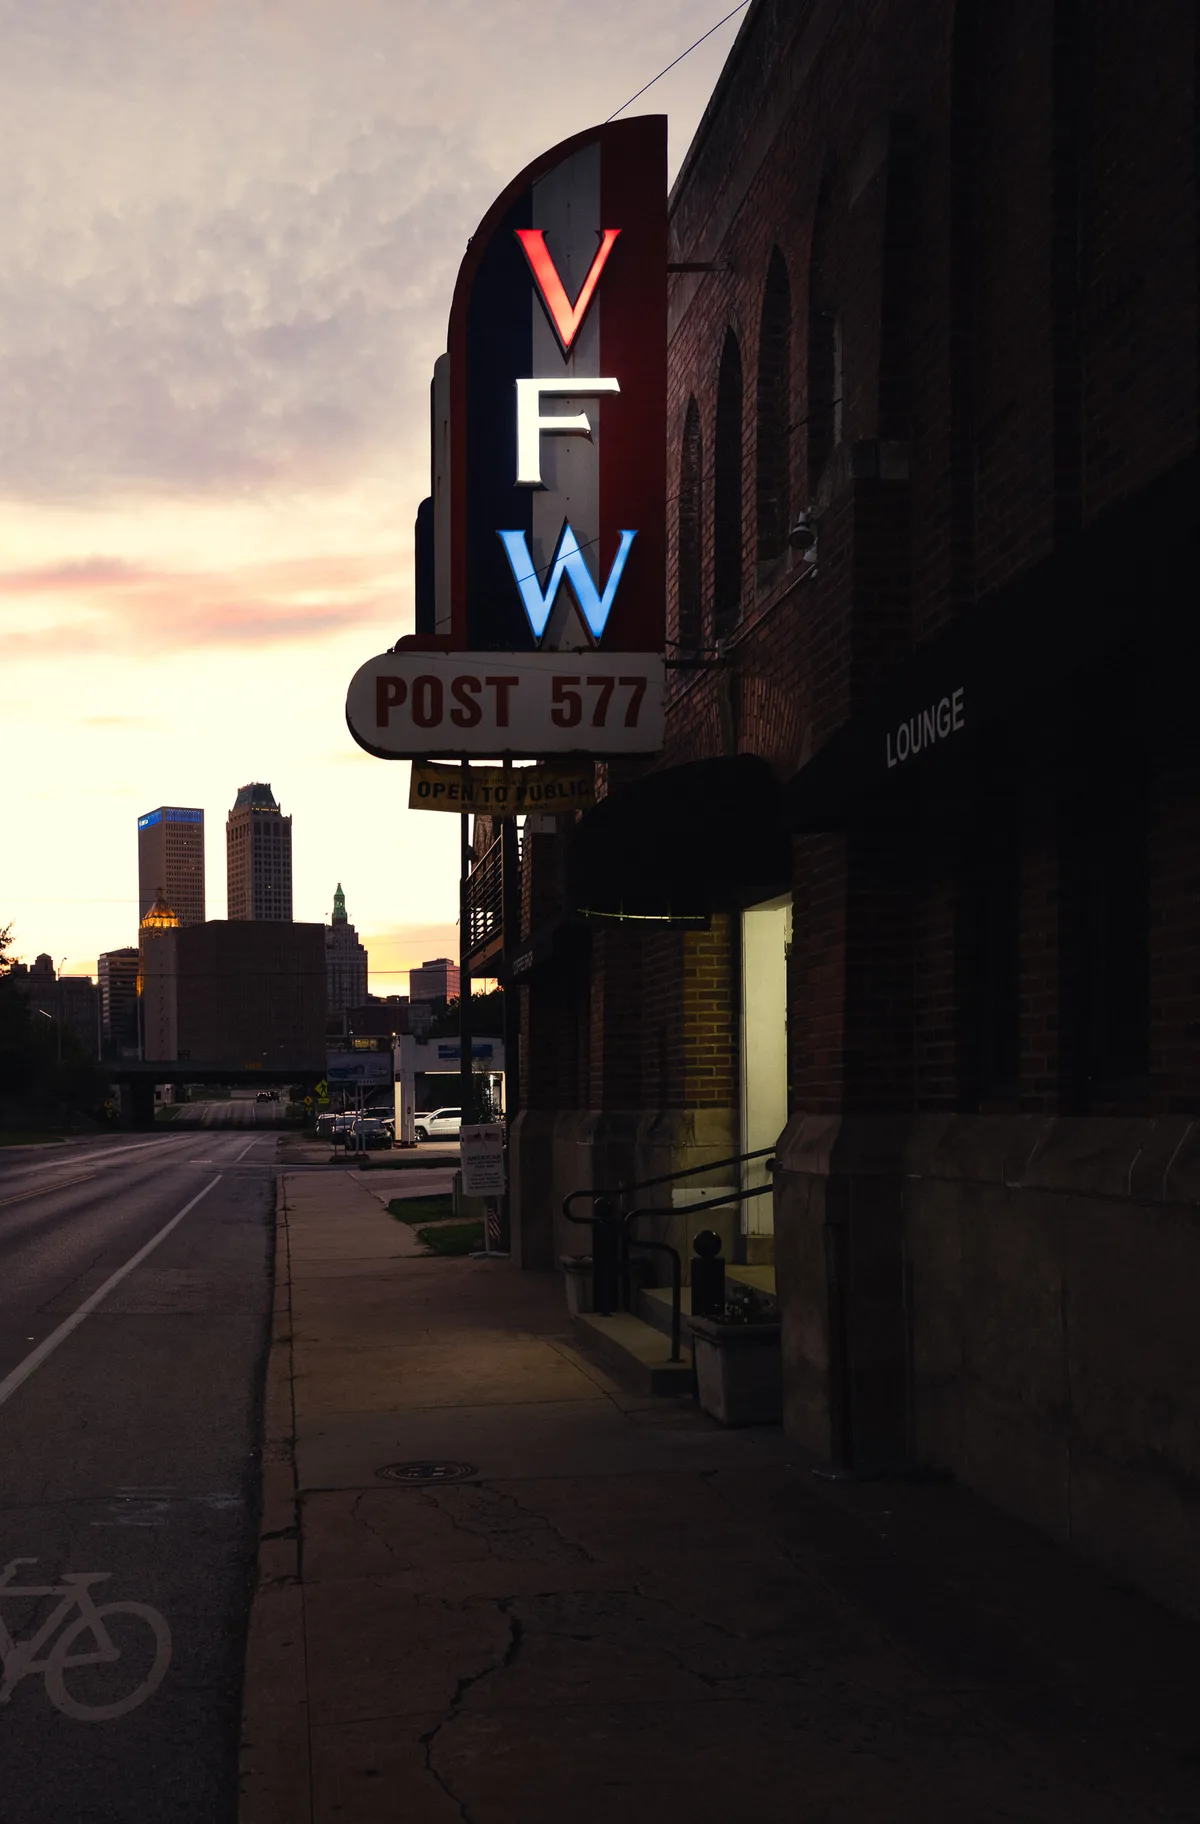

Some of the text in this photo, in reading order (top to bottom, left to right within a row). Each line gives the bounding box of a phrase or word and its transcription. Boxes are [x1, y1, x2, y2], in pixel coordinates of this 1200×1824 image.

[495, 227, 639, 648] VFW
[376, 675, 647, 728] POST 577
[886, 686, 965, 768] LOUNGE
[417, 781, 474, 801] OPEN
[482, 786, 508, 803] TO
[517, 779, 589, 801] PUBLIC
